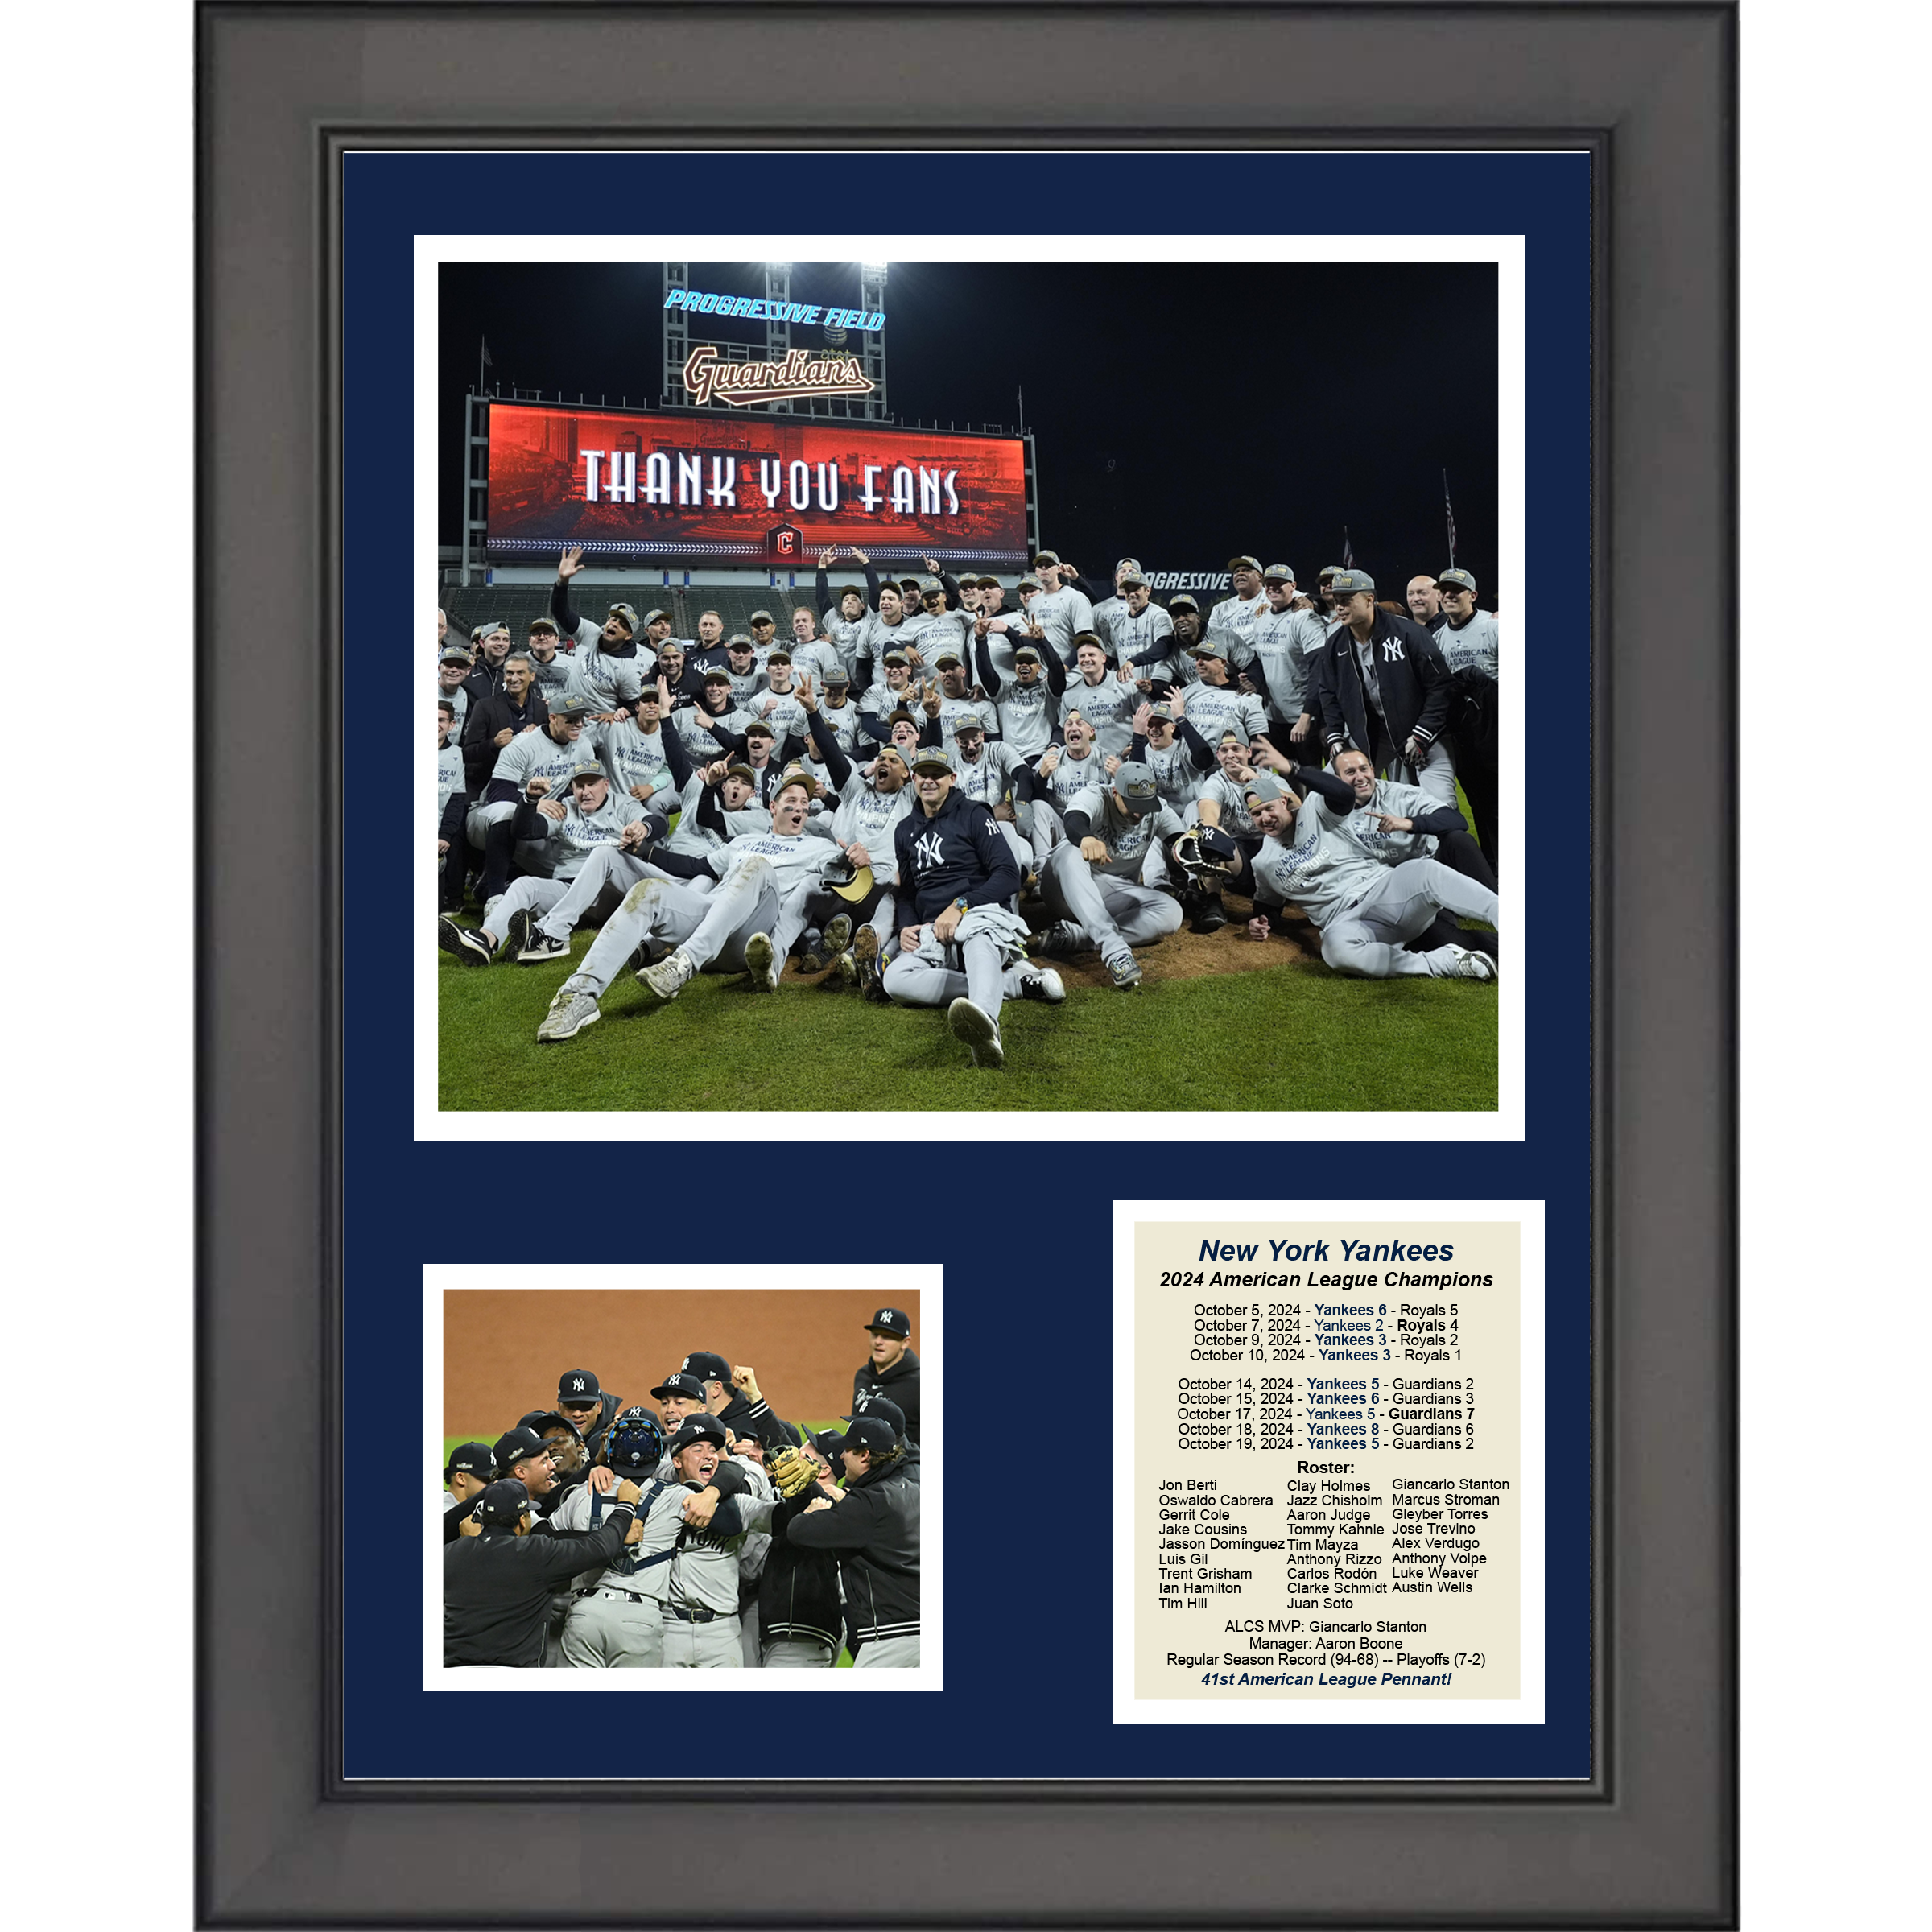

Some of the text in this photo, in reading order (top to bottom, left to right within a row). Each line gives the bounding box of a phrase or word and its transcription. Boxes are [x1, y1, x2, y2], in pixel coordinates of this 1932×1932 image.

[664, 289, 886, 332] PROGRESSIVE FIELD
[683, 347, 875, 406] Guardians
[580, 449, 960, 515] THANK YOU FANS
[777, 531, 793, 555] C
[1144, 572, 1232, 591] OGRESSIVE
[1382, 636, 1406, 663] NY
[1450, 649, 1488, 660] AMERICAN
[1088, 702, 1121, 712] AMERICAN
[1198, 708, 1224, 716] LEAGUE
[1199, 703, 1236, 712] AMERICAN
[627, 755, 653, 766] LEAGUE
[630, 749, 663, 762] AMERICAN
[985, 818, 1001, 836] NY
[755, 840, 796, 852] AMERICAN
[914, 832, 945, 870] NY
[1282, 834, 1319, 866] AMERICAN
[1287, 850, 1315, 873] LEAGUE
[1199, 1240, 1454, 1261] New York Yankees
[1160, 1271, 1493, 1290] 2024 American League Champions
[880, 1311, 893, 1323] NY
[1194, 1303, 1458, 1319] October 5, 2024 Yankees 6 Royals 5
[1194, 1319, 1459, 1334] October 7, 2024 Yankees 2 Royals 4
[572, 1377, 584, 1391] NY
[668, 1373, 681, 1385] NY
[1179, 1377, 1474, 1392] October 14, 2024 Yankees 5 Guardians 2
[1178, 1407, 1475, 1422] October 17, 2024 Yankees 5 Guardians 7
[1298, 1461, 1354, 1473] Roster:
[1158, 1480, 1216, 1490] Jon Berti
[1287, 1480, 1370, 1494] Clay Holmes
[1393, 1479, 1509, 1490] Giancarlo Stanton
[1159, 1495, 1273, 1505] Oswaldo Cabrera
[1287, 1495, 1382, 1505] Jazz Chisholm
[1393, 1494, 1500, 1505] Marcus Stroman
[1159, 1509, 1230, 1521] Gerrit Cole
[1286, 1509, 1370, 1523] Aaron Judge
[1393, 1509, 1488, 1523] Gleyber Torres
[1158, 1524, 1247, 1534] Jake Cousins
[1287, 1523, 1385, 1538] Tommy Kahnle
[1392, 1523, 1476, 1534] Jose Trevino
[1158, 1538, 1285, 1552] Jasson Domínguez
[1287, 1538, 1358, 1553] Tim Mayza
[1392, 1538, 1480, 1551] Alex Verdugo
[1159, 1554, 1208, 1564] Luis Gil
[1286, 1554, 1382, 1567] Anthony Rizzo
[1392, 1553, 1487, 1567] Anthony Volpe
[1158, 1568, 1252, 1579] Trent Grisham
[1287, 1568, 1377, 1579] Carlos Rodón
[1393, 1567, 1479, 1579] Luke Weaver
[1160, 1583, 1241, 1593] Ian Hamilton
[1287, 1583, 1387, 1594] Clarke Schmidt
[1392, 1581, 1472, 1592] Austin Wells
[1158, 1598, 1207, 1608] Tim Hill
[1287, 1598, 1353, 1608] Juan Soto
[1224, 1620, 1426, 1632] ALCS MVP: Giancarlo Stanton
[1250, 1637, 1403, 1652] Manager: Aaron Boone
[1167, 1653, 1485, 1668] Regular Season Record (94-68) Playoffs (7-2)
[1201, 1672, 1452, 1688] 41st American League Pennant!
